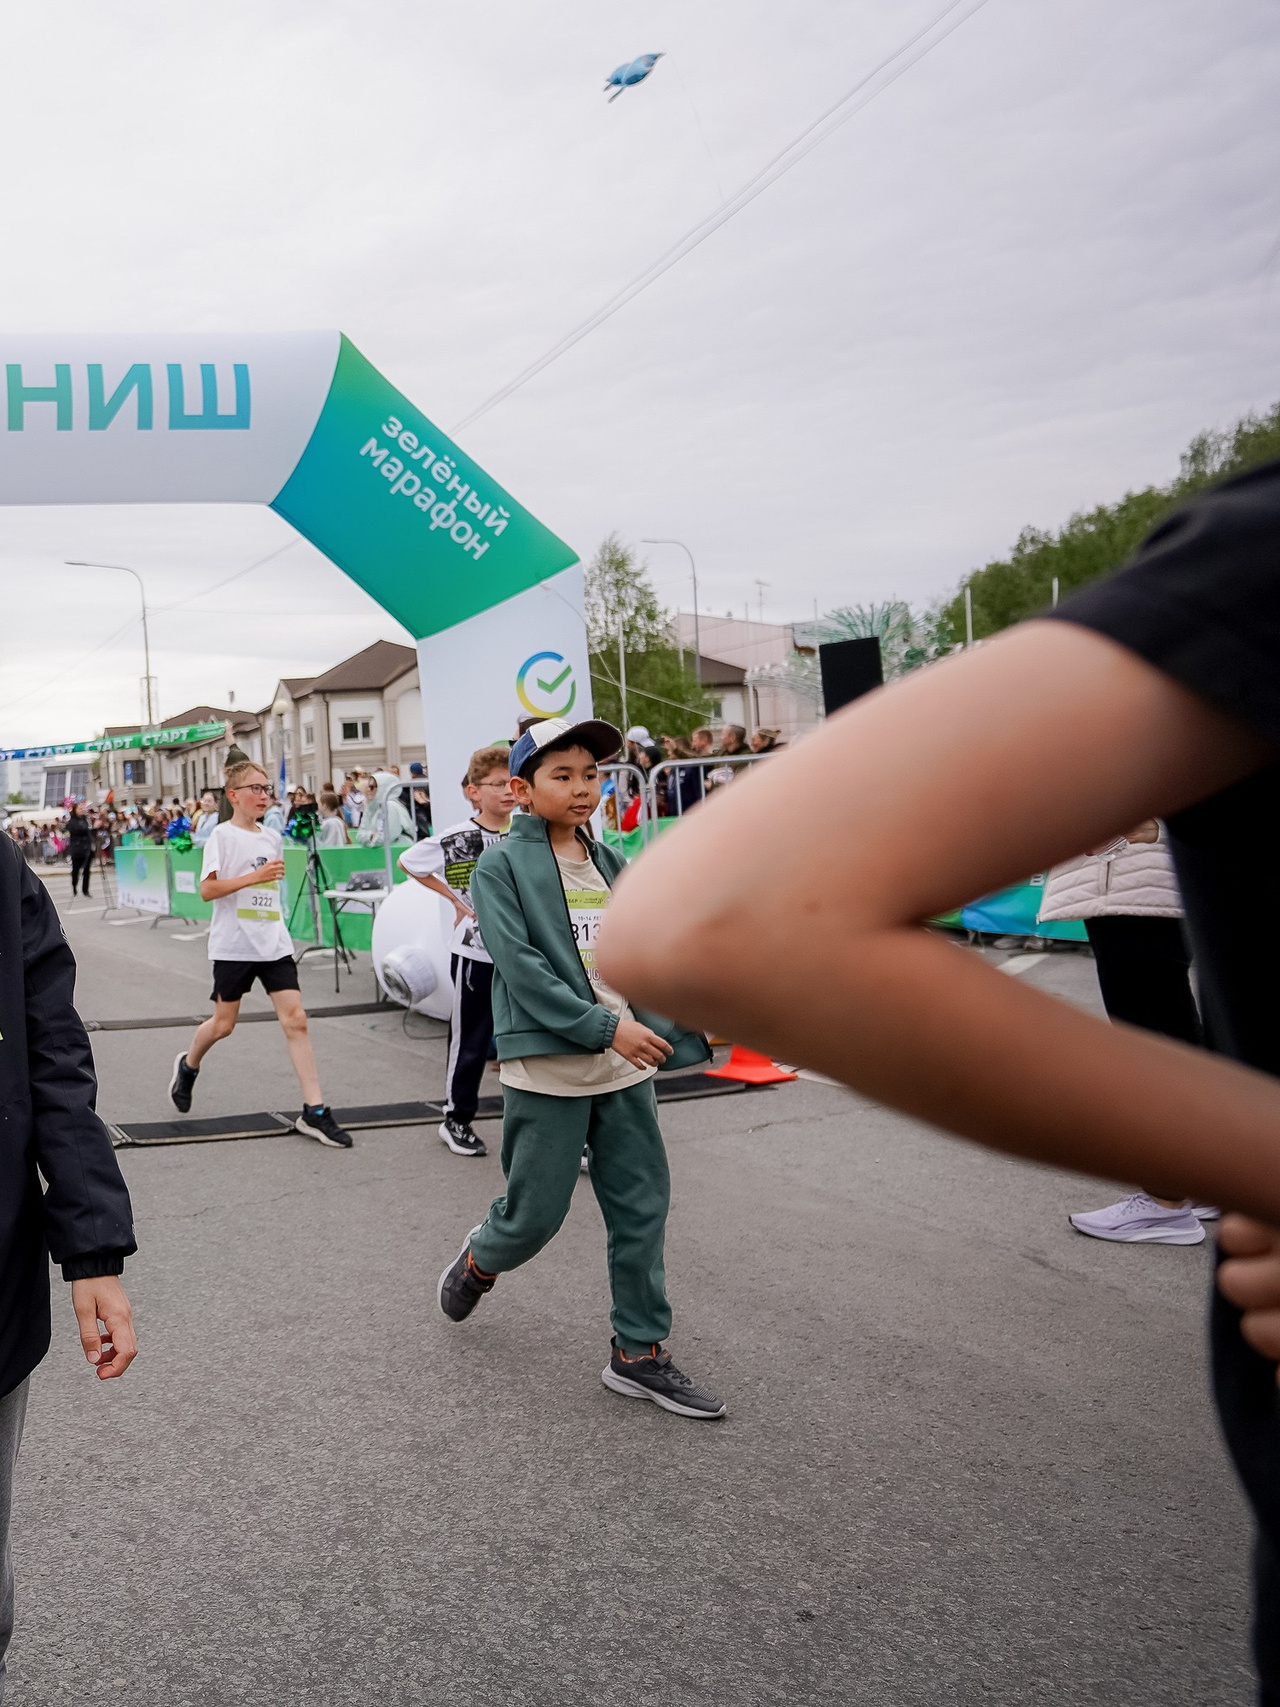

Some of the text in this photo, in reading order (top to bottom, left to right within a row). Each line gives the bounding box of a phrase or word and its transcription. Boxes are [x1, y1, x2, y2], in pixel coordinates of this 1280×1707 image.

[359, 437, 491, 561] марафон
[381, 415, 511, 537] зелёный
[84, 738, 133, 752] СТАРТ
[142, 729, 190, 746] СТАРТ
[251, 896, 272, 907] 3222
